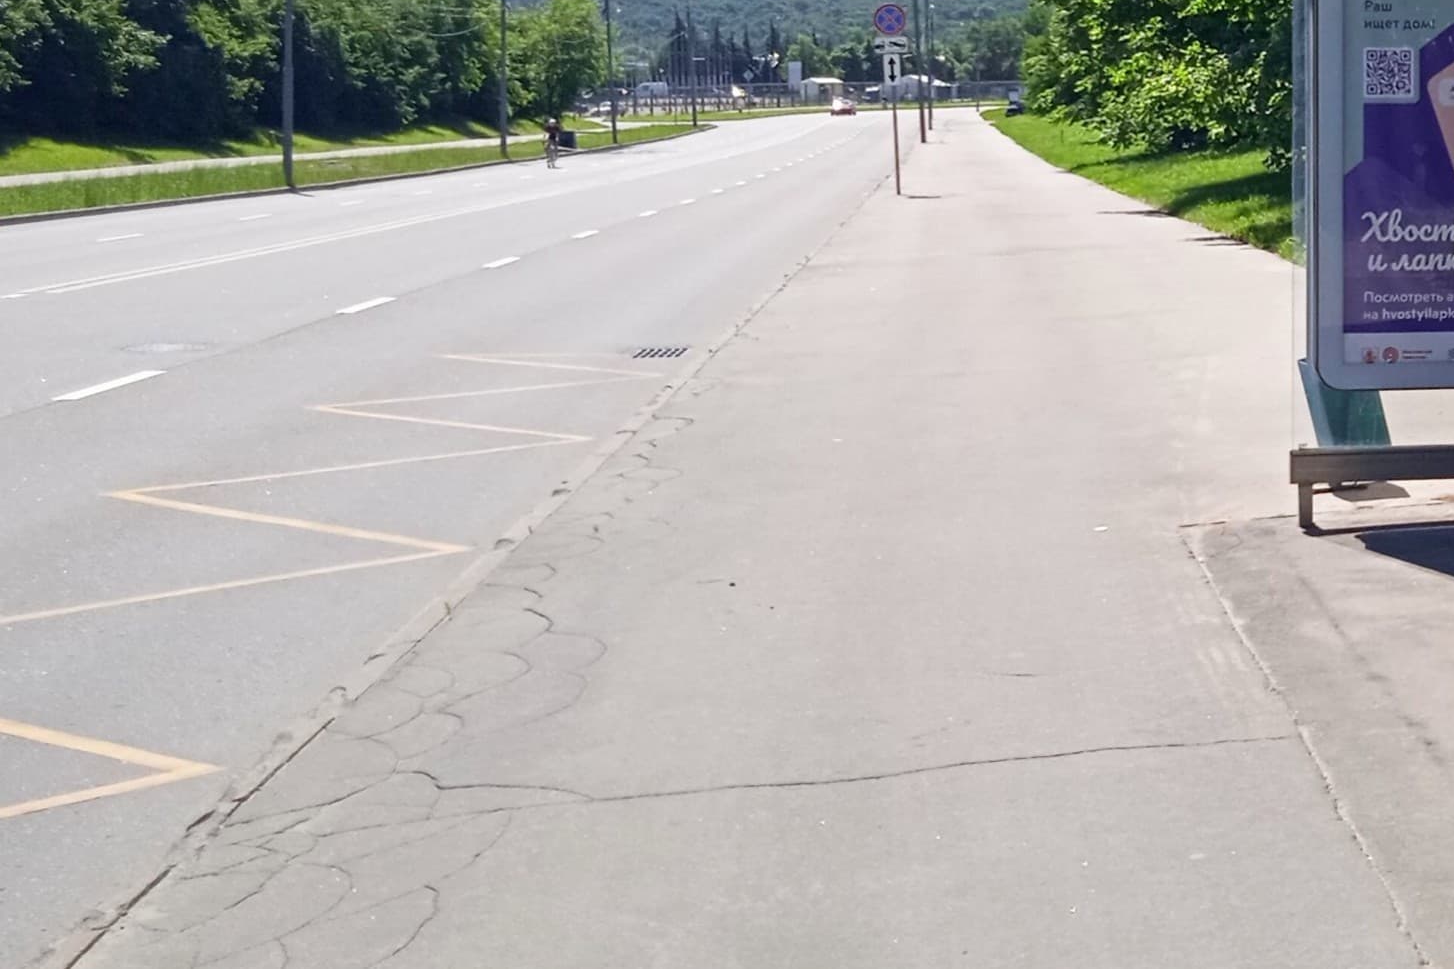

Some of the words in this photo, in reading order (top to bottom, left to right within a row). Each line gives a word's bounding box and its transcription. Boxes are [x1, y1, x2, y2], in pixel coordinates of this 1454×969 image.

[1364, 0, 1393, 12] Раш
[1363, 19, 1400, 30] ищет
[1367, 252, 1389, 272] и
[1363, 290, 1444, 306] Посмотреть
[1363, 310, 1379, 320] на
